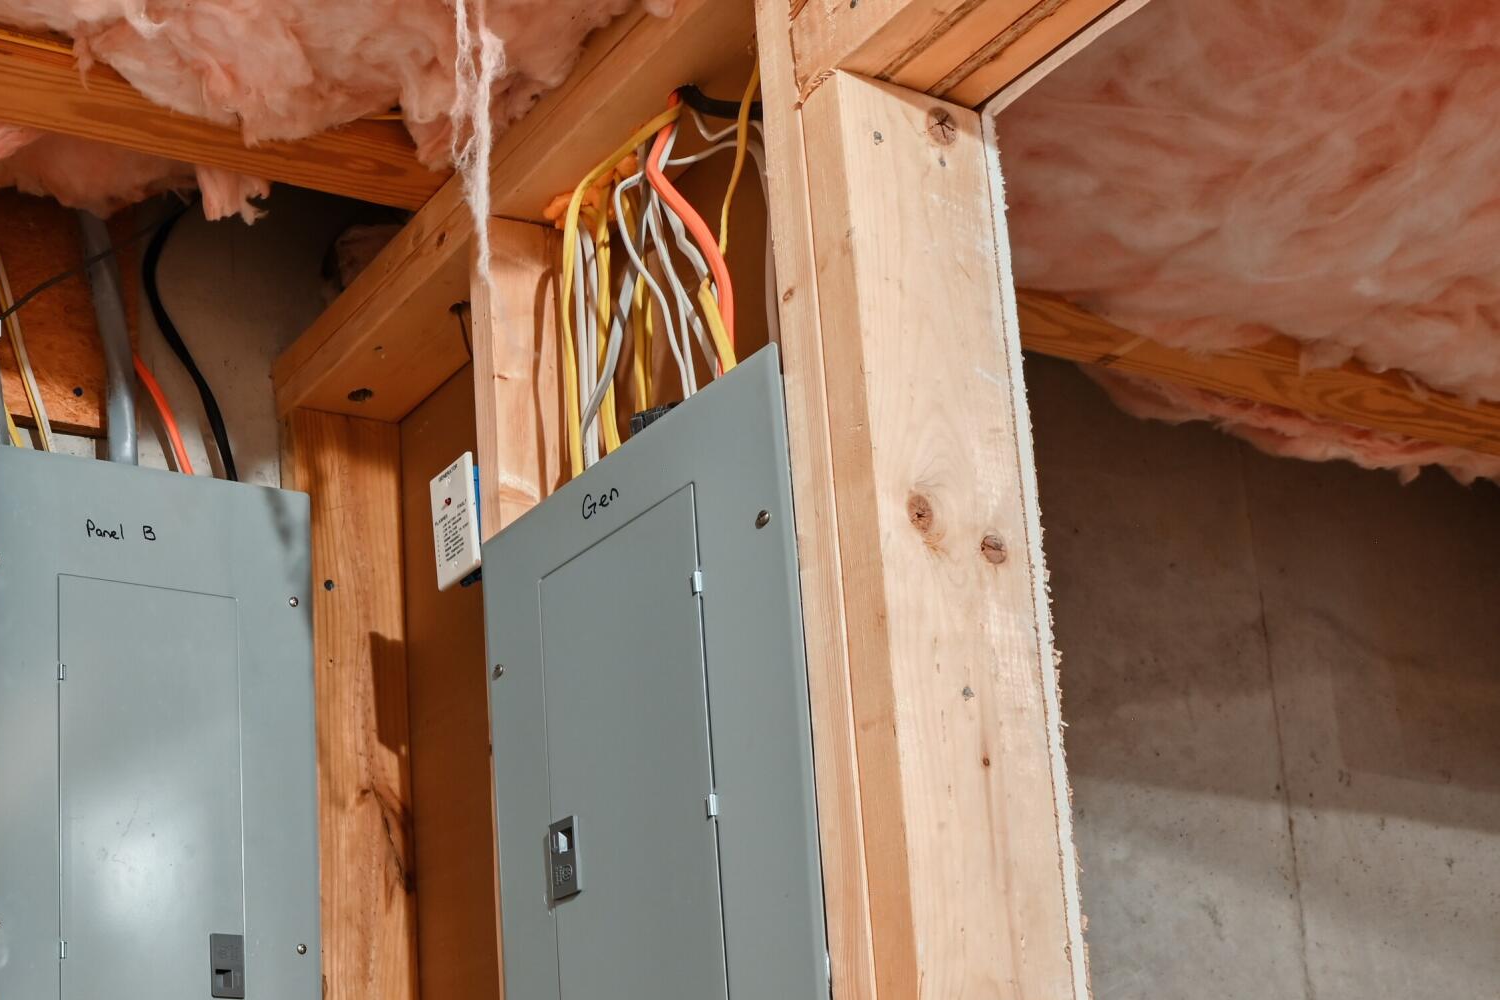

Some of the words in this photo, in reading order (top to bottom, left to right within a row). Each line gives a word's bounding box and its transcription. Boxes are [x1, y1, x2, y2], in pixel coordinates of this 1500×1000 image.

[581, 487, 619, 520] Gen
[86, 518, 125, 540] Panel
[142, 525, 157, 541] B
